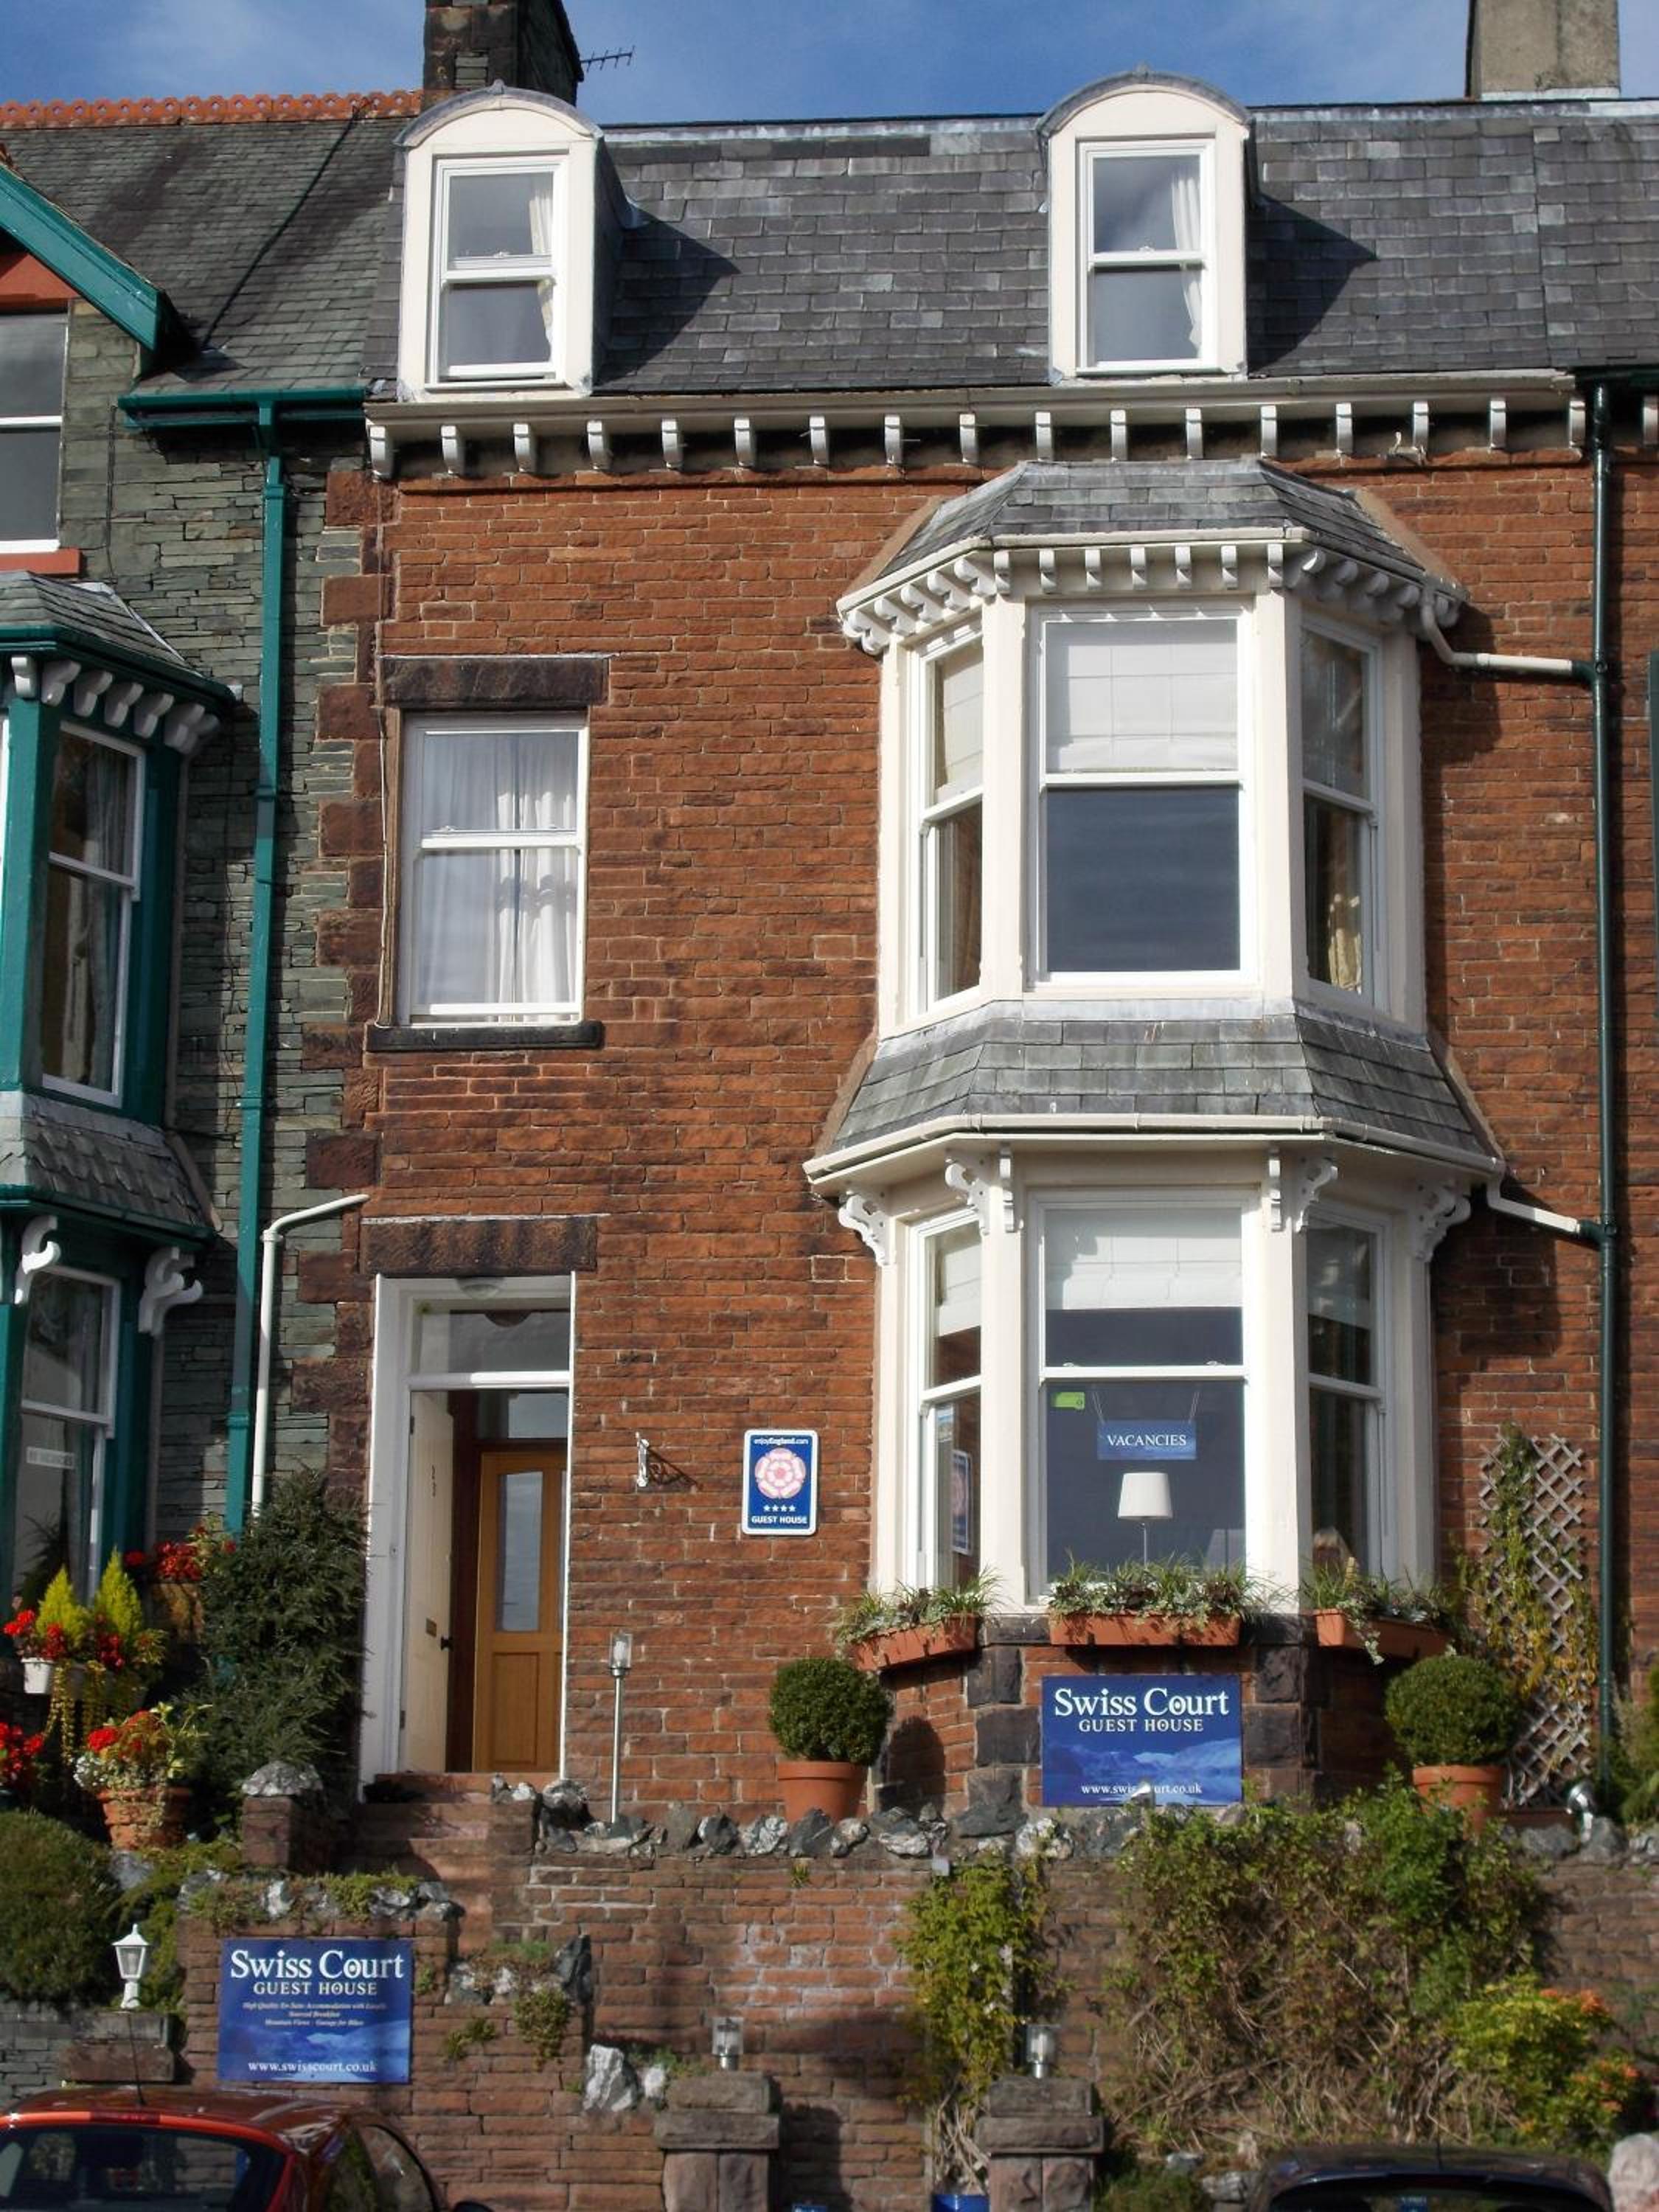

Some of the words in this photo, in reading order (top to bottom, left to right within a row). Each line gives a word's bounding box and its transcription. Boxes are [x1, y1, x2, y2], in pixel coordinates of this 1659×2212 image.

[1107, 1435, 1186, 1446] VACANCIES
[751, 1515, 776, 1524] GUEST
[780, 1516, 808, 1524] HOUSE
[1055, 1688, 1138, 1717] Swiss
[1144, 1688, 1230, 1717] Court
[1079, 1719, 1137, 1732] GUEST
[1144, 1719, 1204, 1732] HOUSE
[1081, 1782, 1203, 1795] www.swisurt.co.uk
[231, 1950, 313, 1979] Swiss
[319, 1950, 405, 1979] Court
[253, 1982, 312, 1995] GUEST
[319, 1982, 378, 1995] HOUSE
[248, 2059, 378, 2073] www.swisscourt.co.uk
